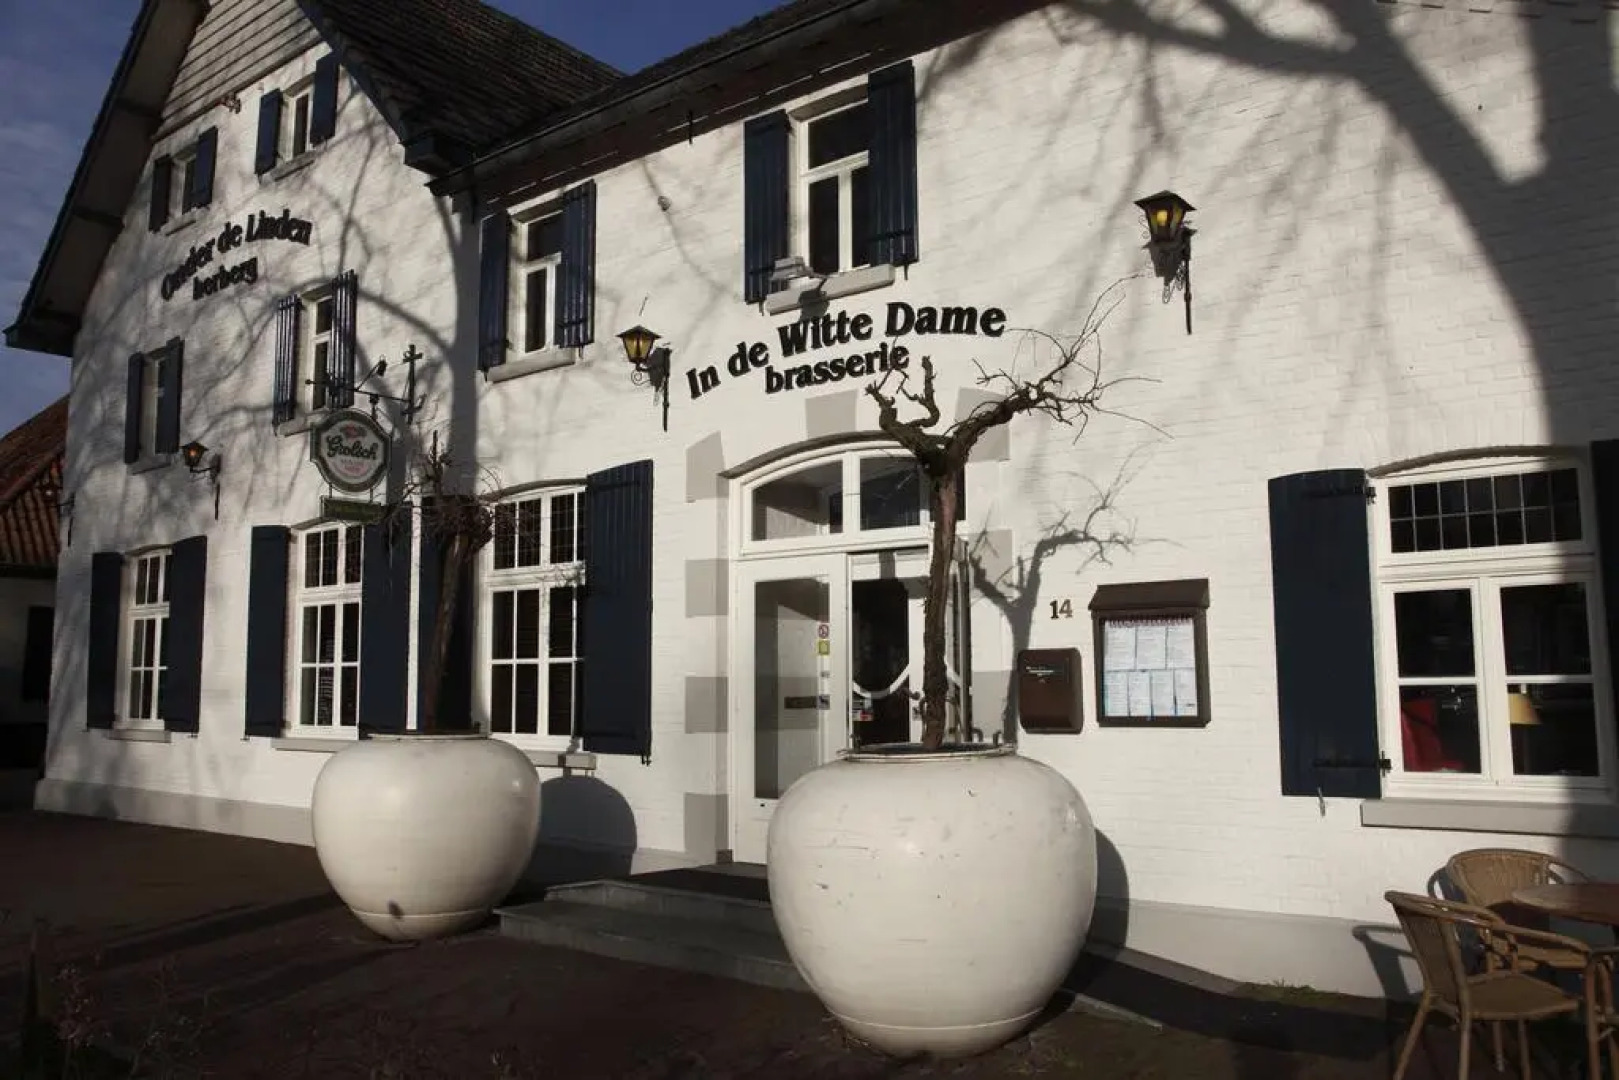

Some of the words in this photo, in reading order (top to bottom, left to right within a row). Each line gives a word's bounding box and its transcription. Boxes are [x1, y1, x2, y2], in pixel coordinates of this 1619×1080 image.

[217, 221, 243, 253] de
[245, 208, 312, 245] Linden
[193, 257, 258, 300] herberg
[686, 364, 721, 399] In
[728, 341, 769, 377] de
[777, 309, 873, 357] Witte
[885, 301, 1006, 337] Dame
[764, 342, 909, 394] brasserie
[326, 435, 378, 460] Grolsch
[1049, 599, 1073, 620] 14
